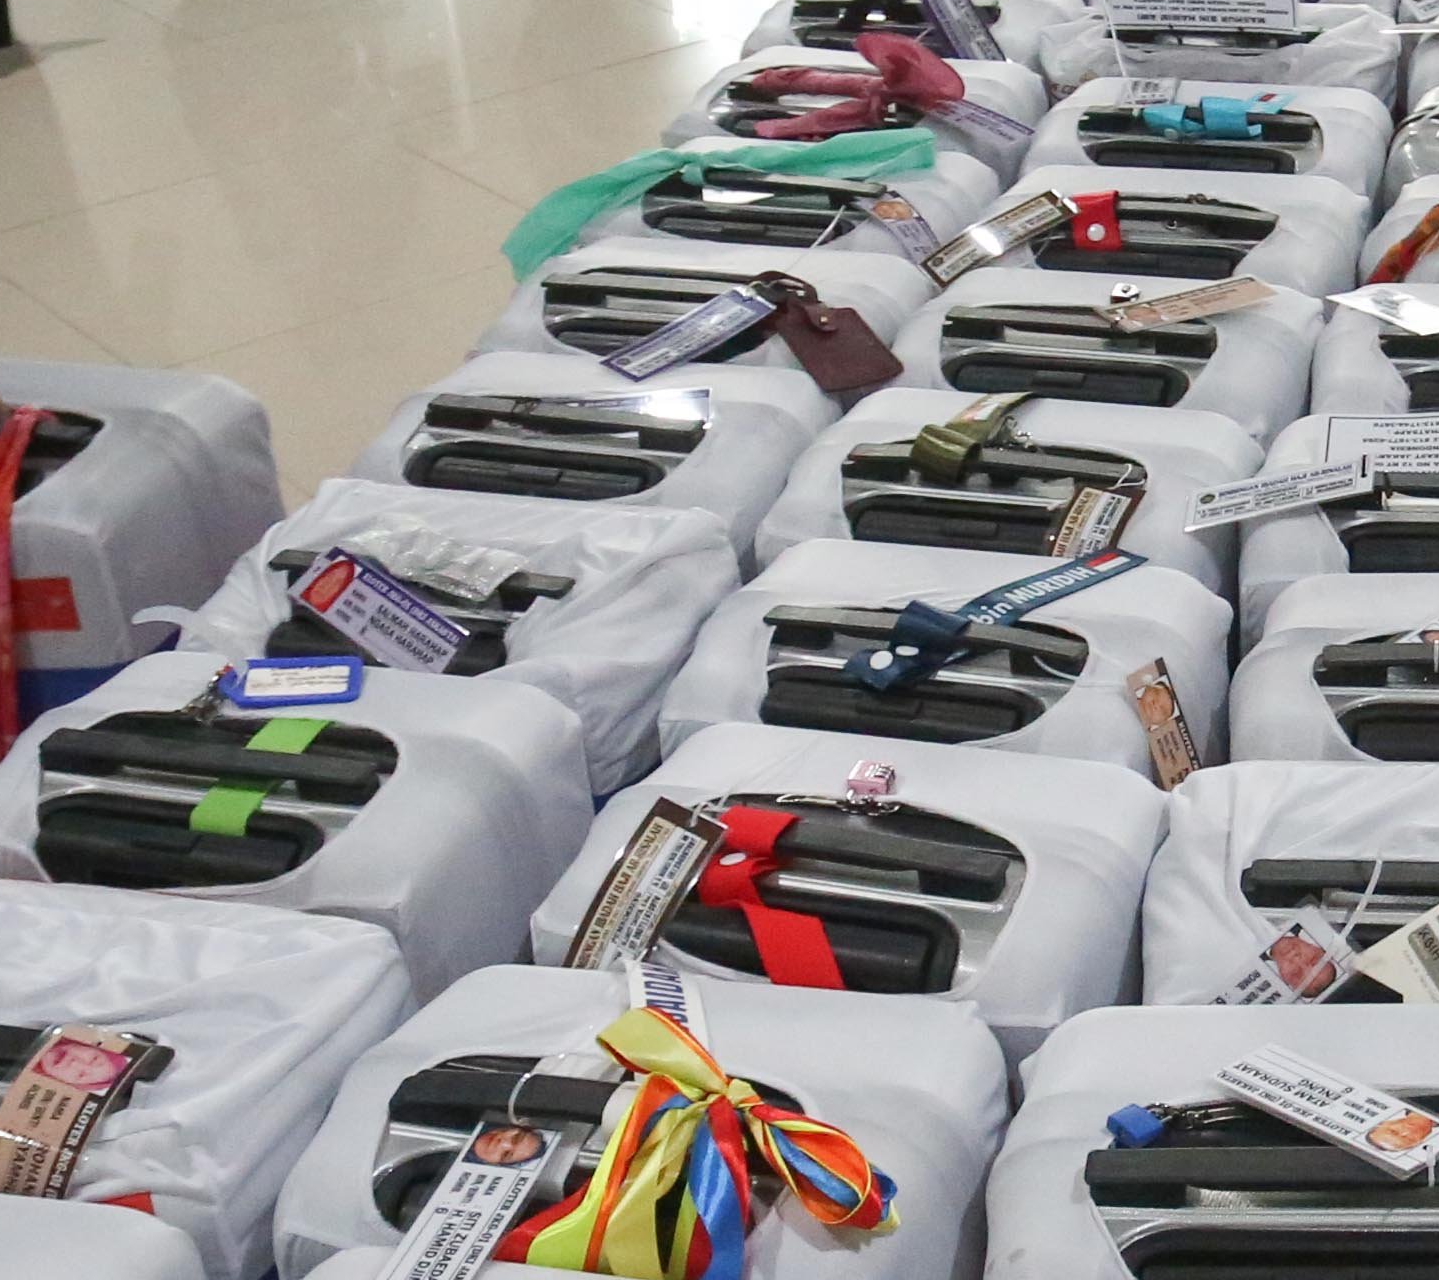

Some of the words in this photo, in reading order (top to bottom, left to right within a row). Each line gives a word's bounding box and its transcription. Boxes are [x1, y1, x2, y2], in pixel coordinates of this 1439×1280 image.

[967, 600, 1012, 626] bin
[1004, 566, 1096, 606] MURIDIH
[389, 632, 439, 666] HARAHAP
[404, 624, 454, 657] HARAHAP
[1233, 1060, 1296, 1094] SUDRAJAT
[1296, 1077, 1342, 1102] ENUNG
[1293, 1088, 1331, 1109] ATAM
[63, 1099, 99, 1147] KLOTER
[1312, 1114, 1352, 1136] KLOTER
[483, 1176, 503, 1195] NAMA
[499, 1176, 529, 1211] KLOTER
[432, 1206, 450, 1215] 6
[457, 1210, 483, 1231] SITI
[422, 1222, 456, 1259] HAMID
[477, 1212, 505, 1243] JKG-01
[461, 1243, 485, 1265] (DKI
